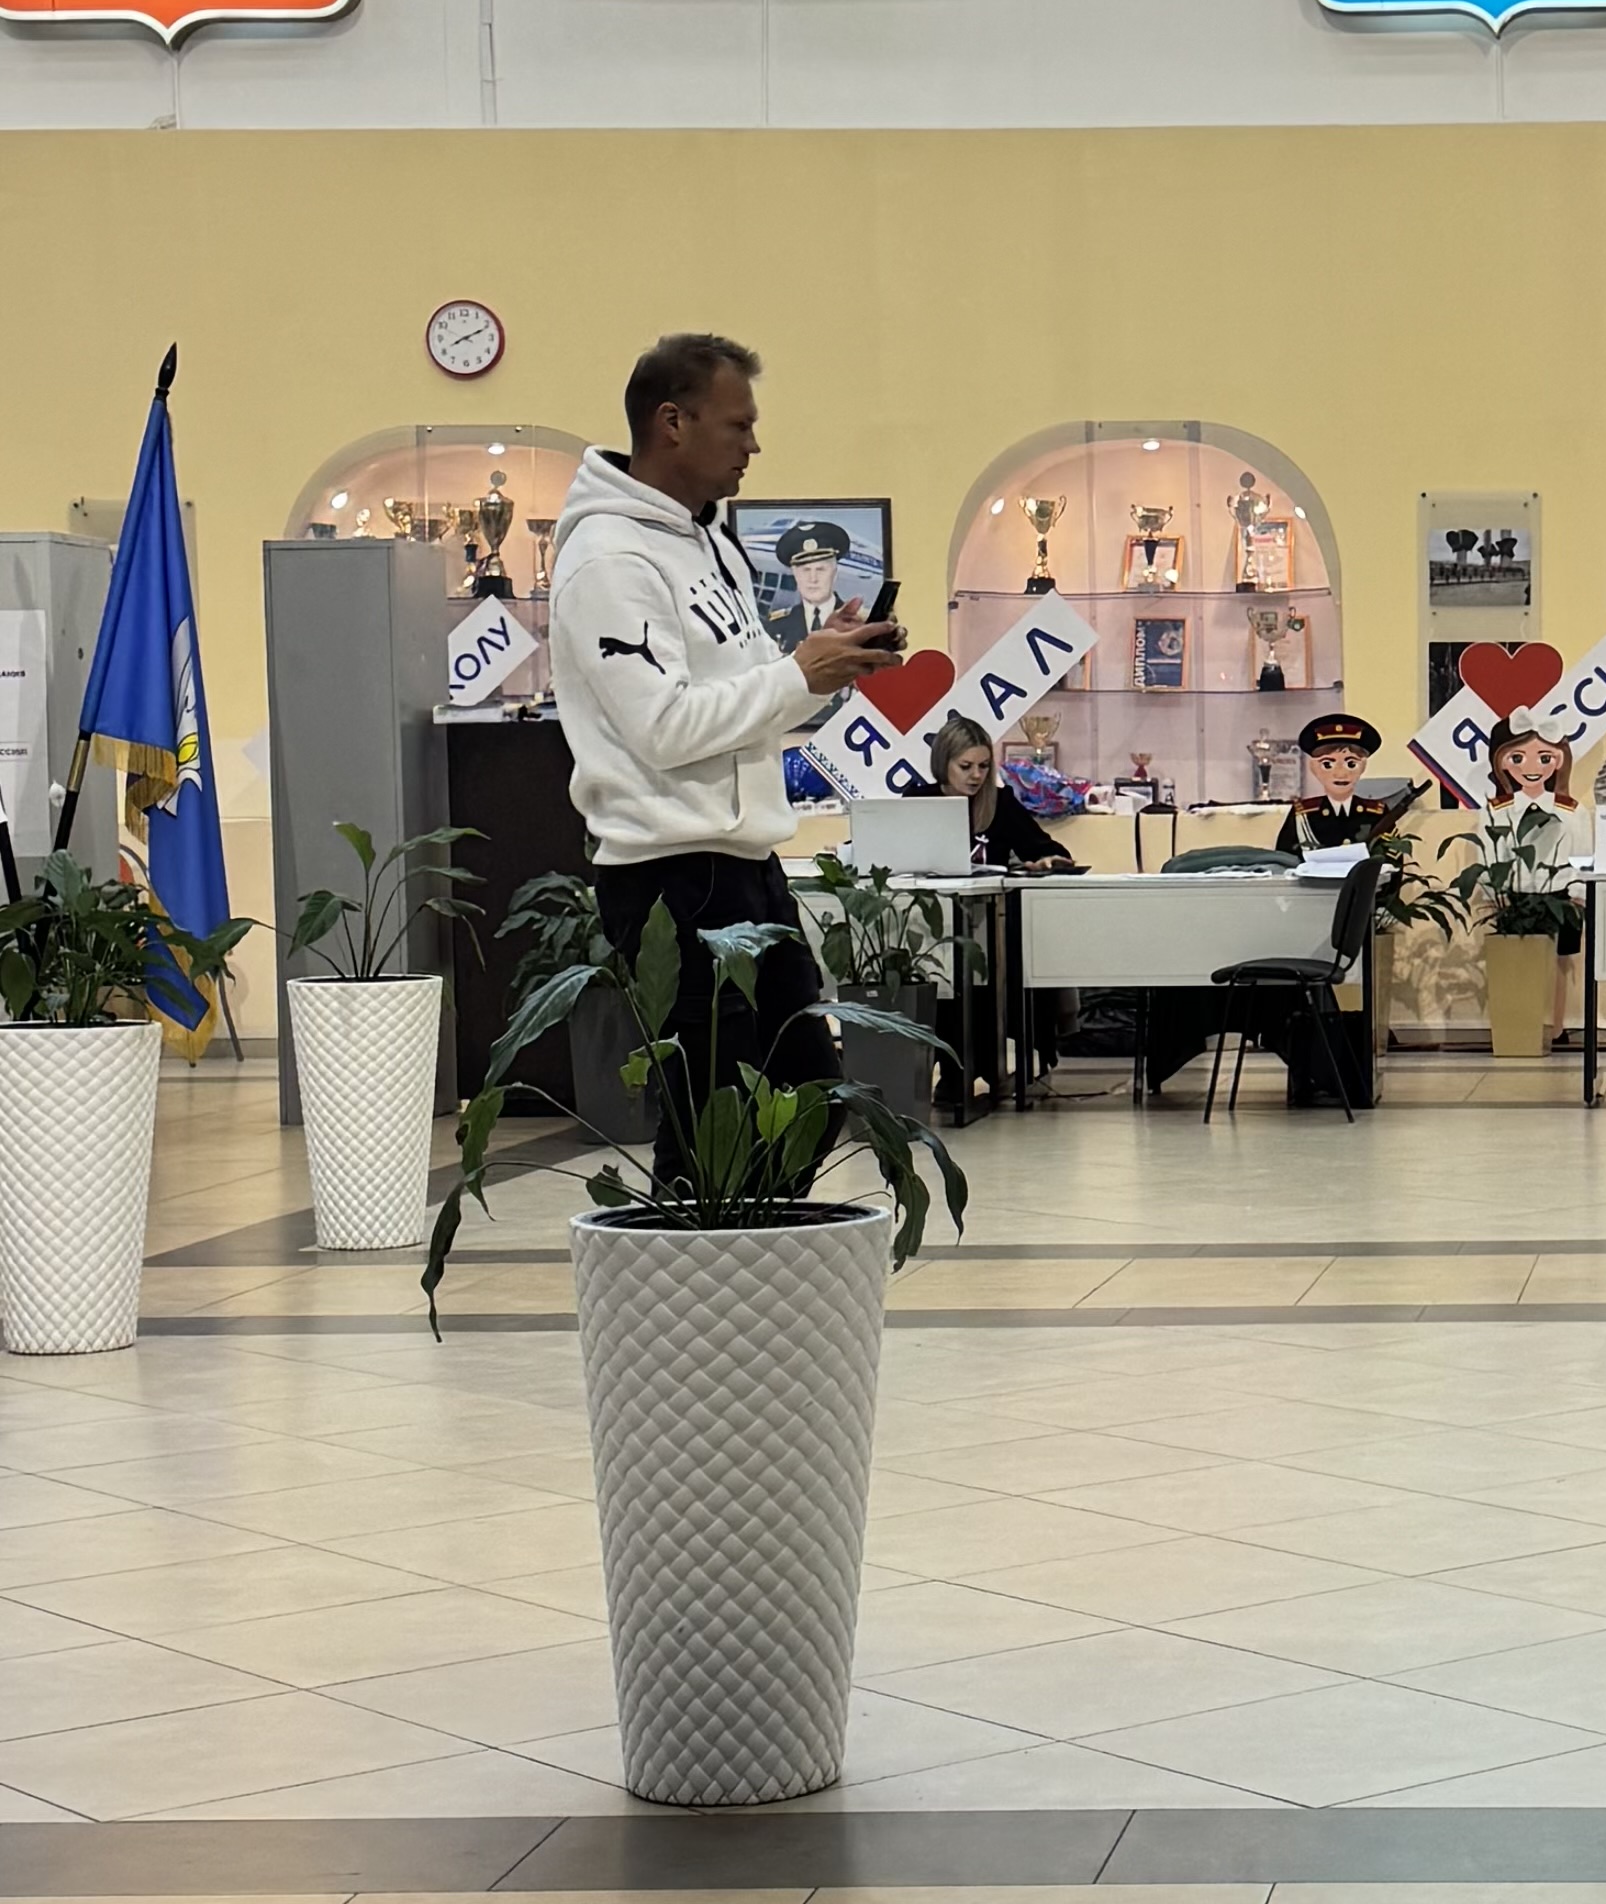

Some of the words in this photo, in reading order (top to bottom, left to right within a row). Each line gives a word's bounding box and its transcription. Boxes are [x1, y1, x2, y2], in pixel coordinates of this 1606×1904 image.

[447, 312, 456, 320] 11
[449, 616, 511, 701] ОЛУ
[1134, 626, 1146, 688] ДИПЛОМ
[886, 627, 1074, 795] ЯАЛ
[1452, 717, 1492, 762] Я
[844, 715, 891, 767] Я
